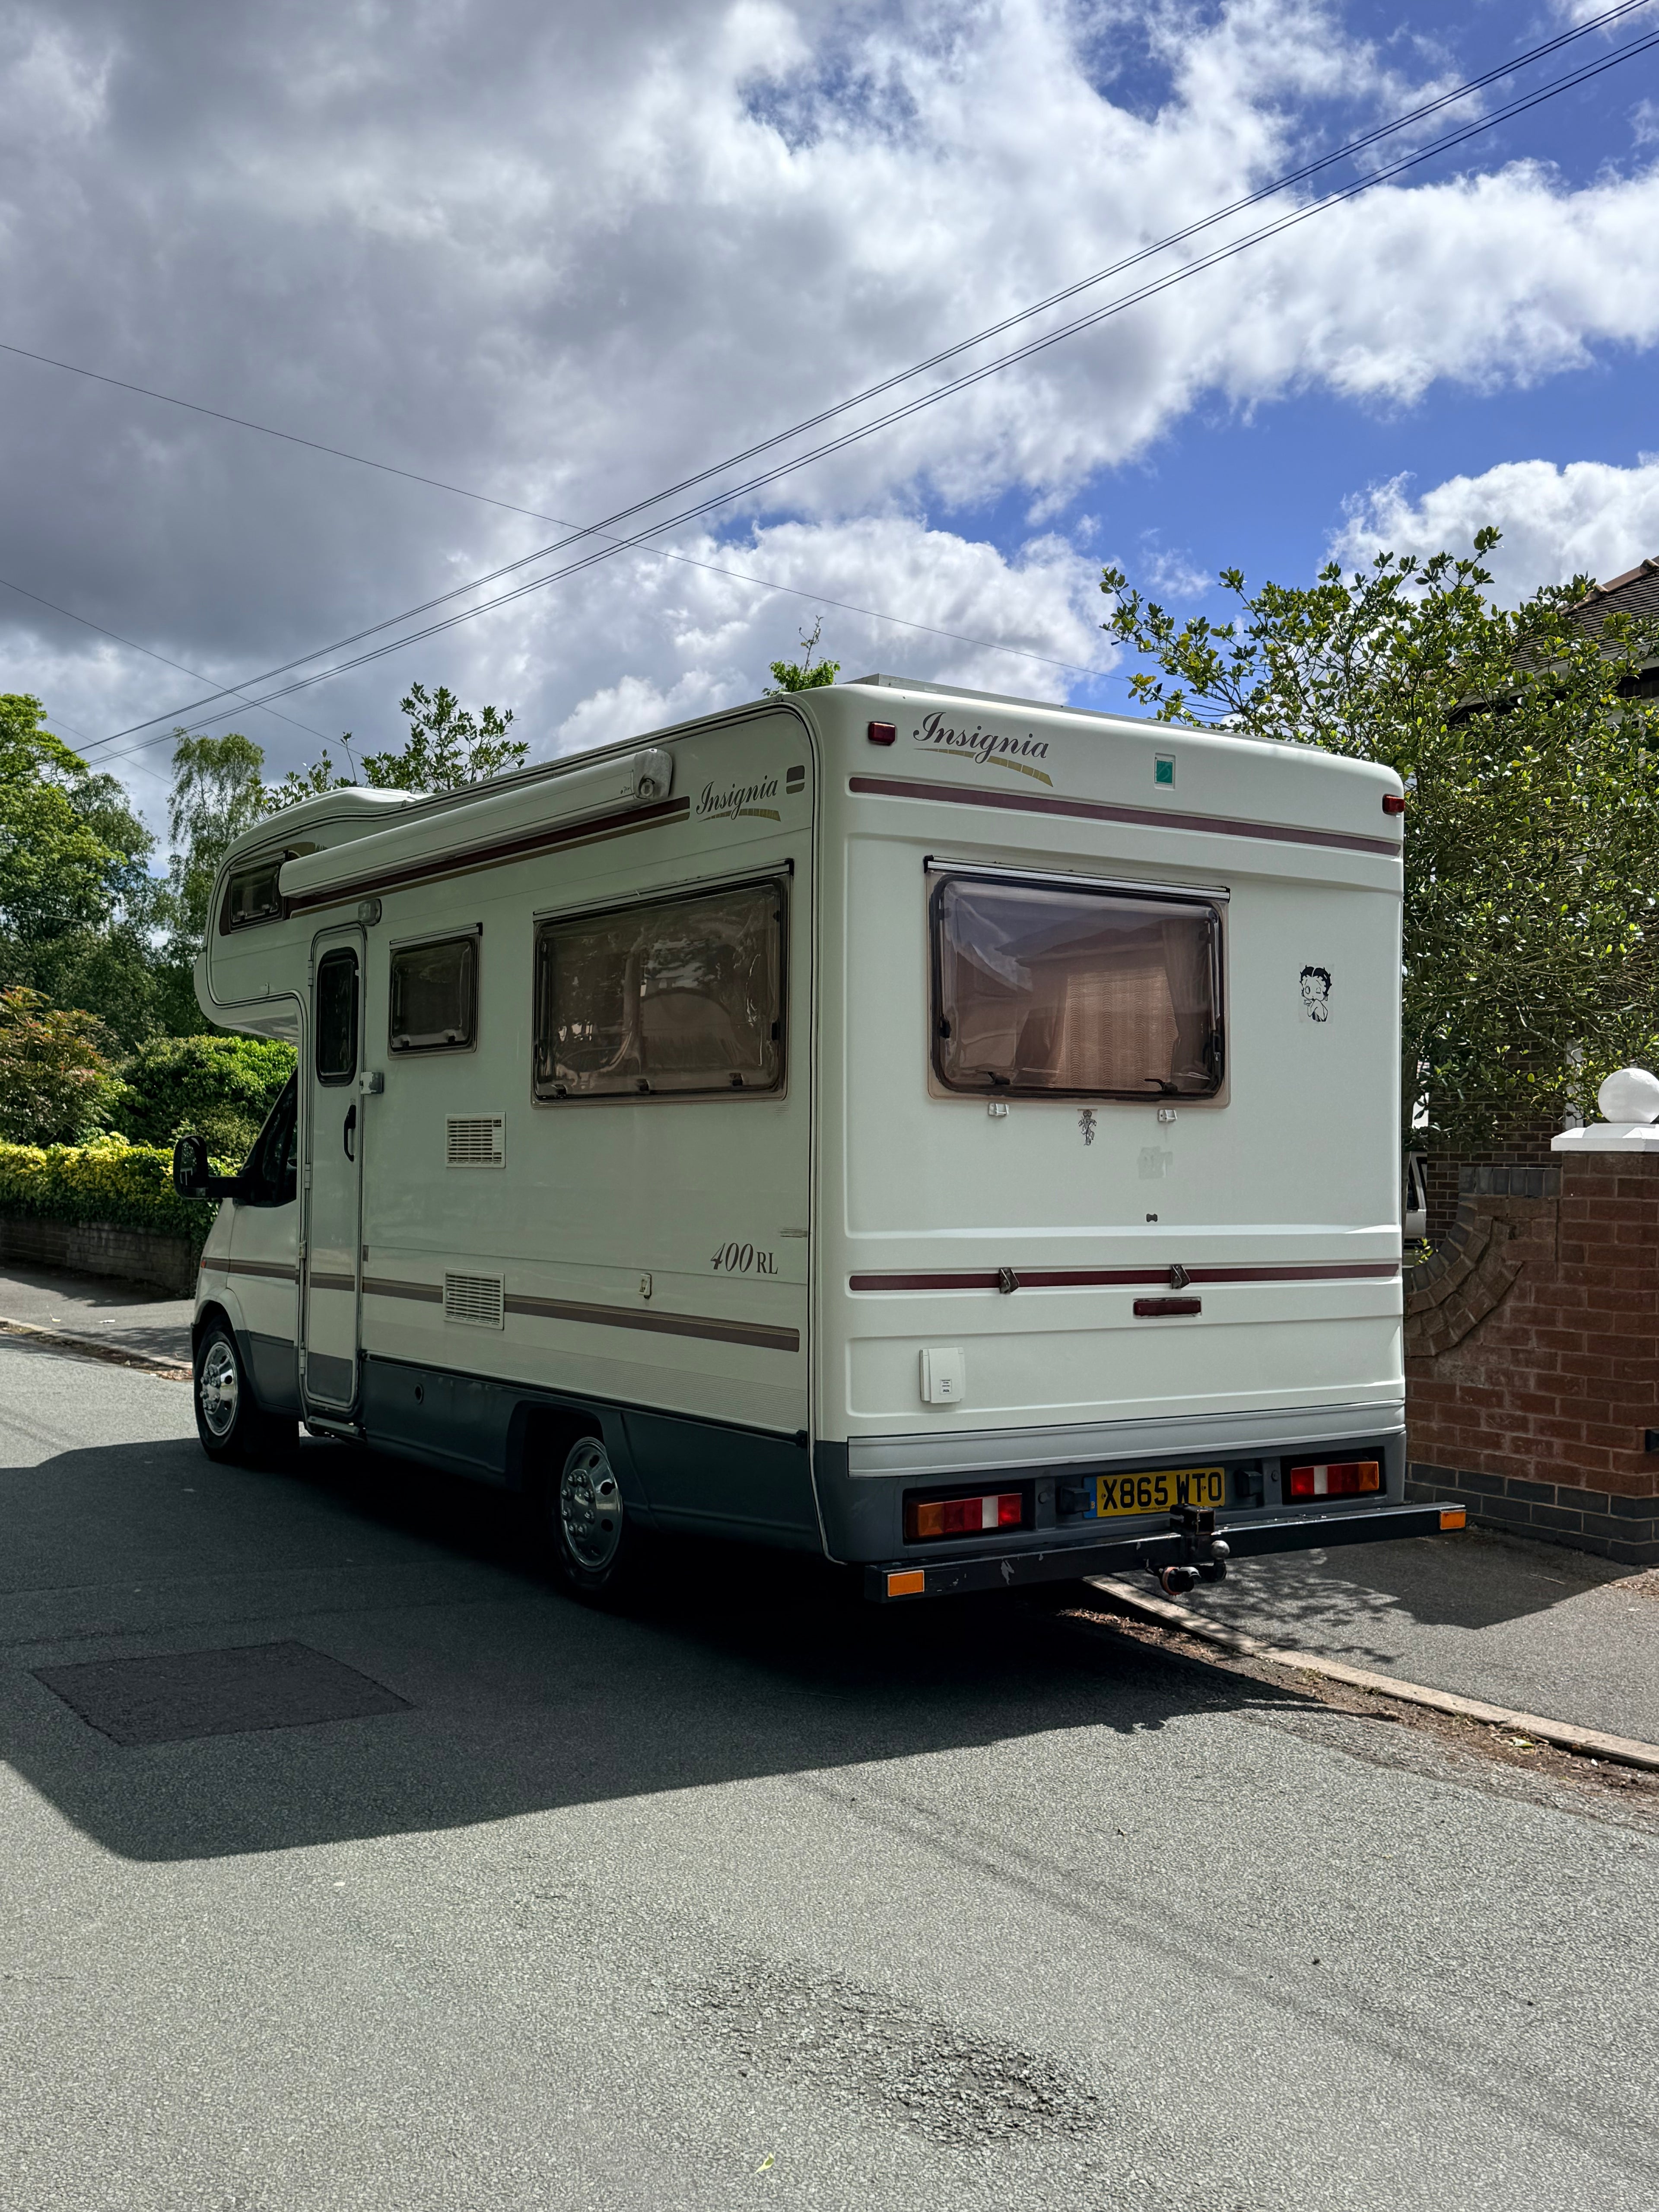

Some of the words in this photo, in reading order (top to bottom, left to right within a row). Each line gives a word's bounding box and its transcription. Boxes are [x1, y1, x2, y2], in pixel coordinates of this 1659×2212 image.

[913, 712, 1049, 764] Insignia
[696, 775, 779, 820] Insignia
[710, 1243, 753, 1272] 400
[756, 1252, 778, 1274] RL
[1103, 1475, 1168, 1510] X865
[1176, 1471, 1222, 1504] WTO
